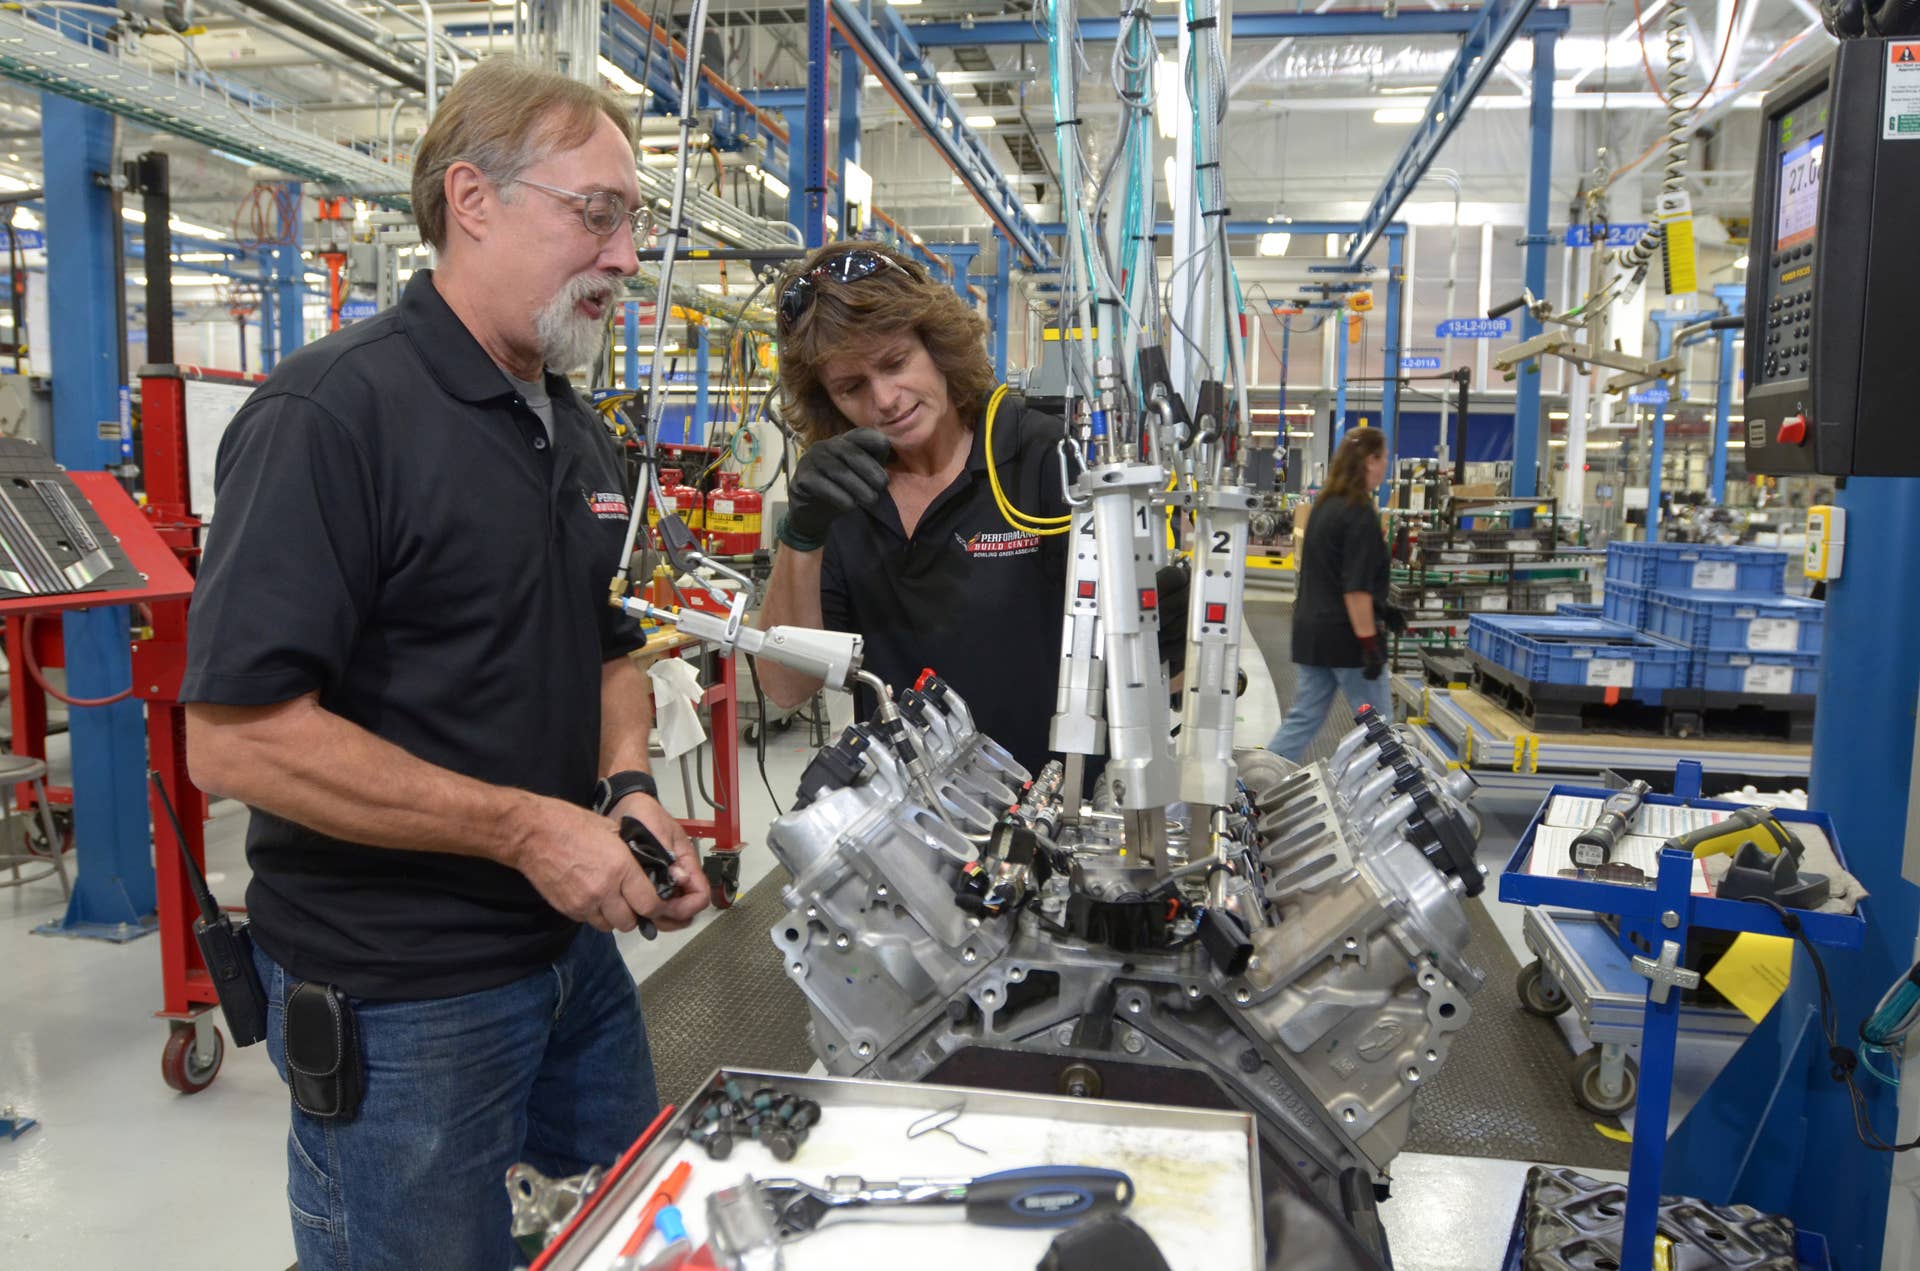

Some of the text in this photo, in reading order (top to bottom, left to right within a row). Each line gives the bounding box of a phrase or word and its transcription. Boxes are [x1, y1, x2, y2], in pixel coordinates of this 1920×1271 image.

[1080, 516, 1096, 539] 4
[1136, 506, 1147, 530] 1
[975, 536, 1039, 551] BUILD CENTER
[980, 529, 1040, 543] PERFORMAN
[1212, 531, 1231, 554] 2
